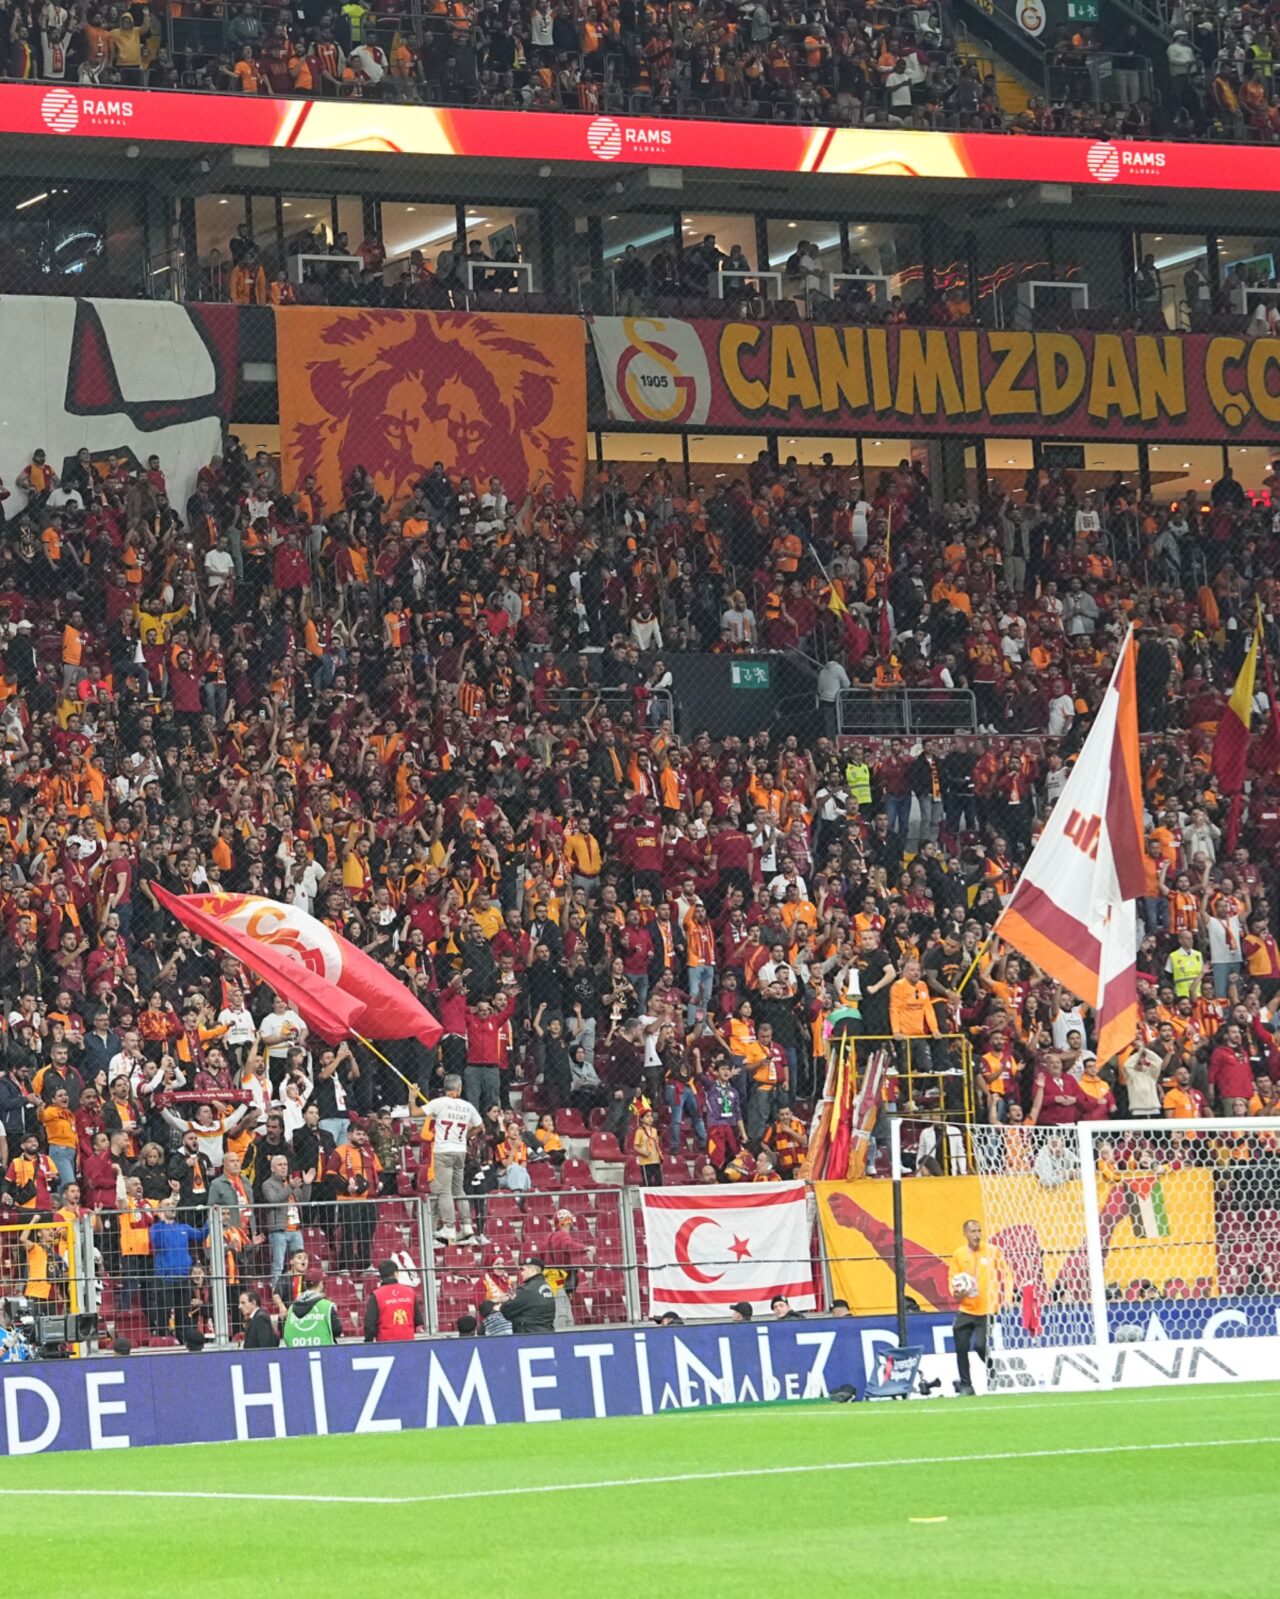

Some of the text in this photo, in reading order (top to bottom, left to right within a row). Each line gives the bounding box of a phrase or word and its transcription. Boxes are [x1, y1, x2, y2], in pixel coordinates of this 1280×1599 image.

[83, 99, 134, 117] RAMS
[91, 118, 127, 126] GLOBAL
[625, 128, 672, 145] RAMS
[1122, 151, 1166, 167] RAMS
[638, 371, 670, 389] 1905
[719, 321, 1188, 424] CANIMIZDAN
[440, 1119, 469, 1141] 77
